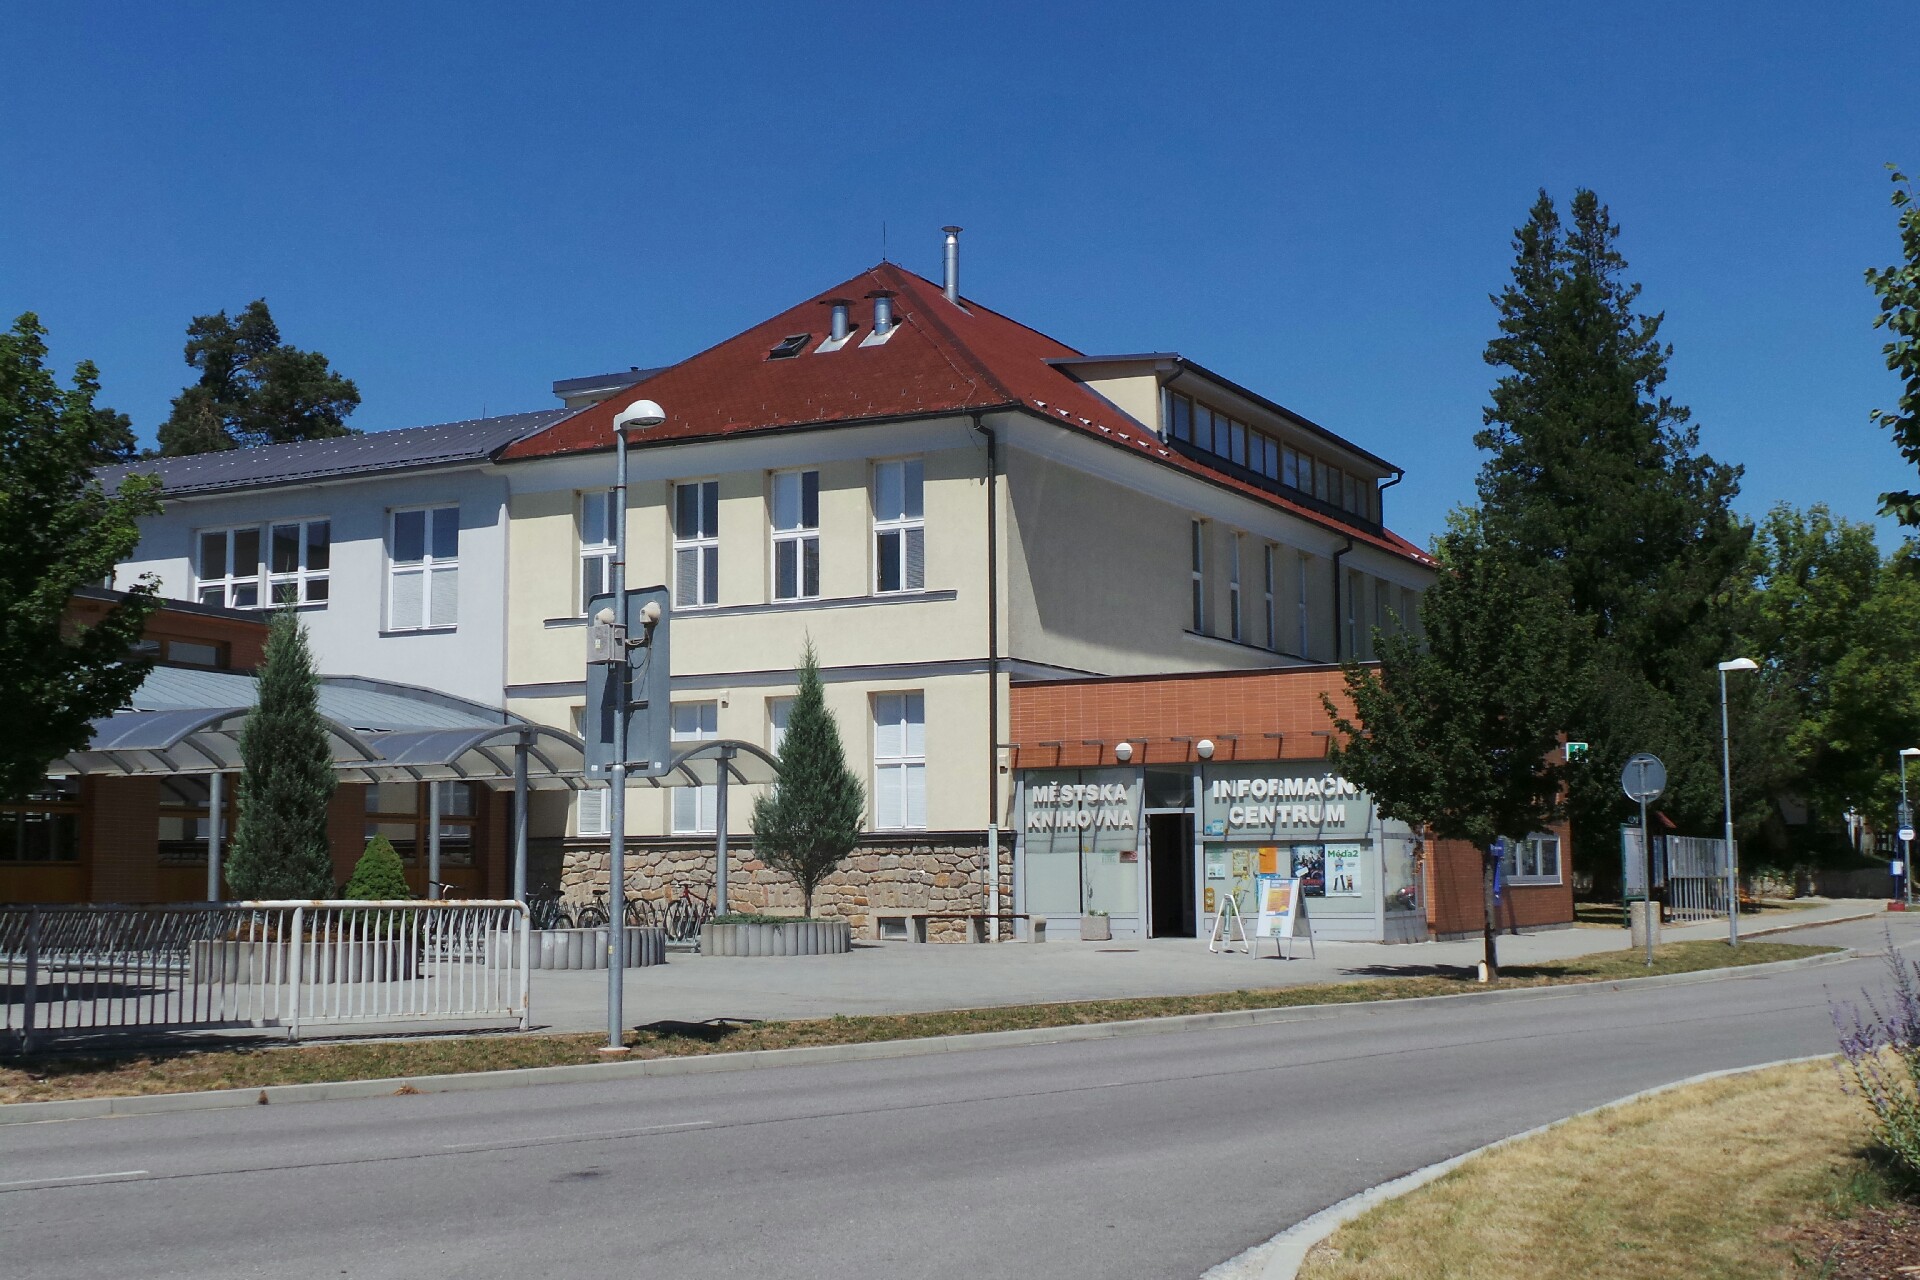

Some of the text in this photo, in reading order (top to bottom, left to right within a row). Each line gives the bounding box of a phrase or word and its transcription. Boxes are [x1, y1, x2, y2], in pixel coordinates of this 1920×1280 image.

[1213, 773, 1360, 798] INFORMAČN
[1027, 809, 1134, 829] KNIHOVNA
[1229, 804, 1346, 824] CENTRUM
